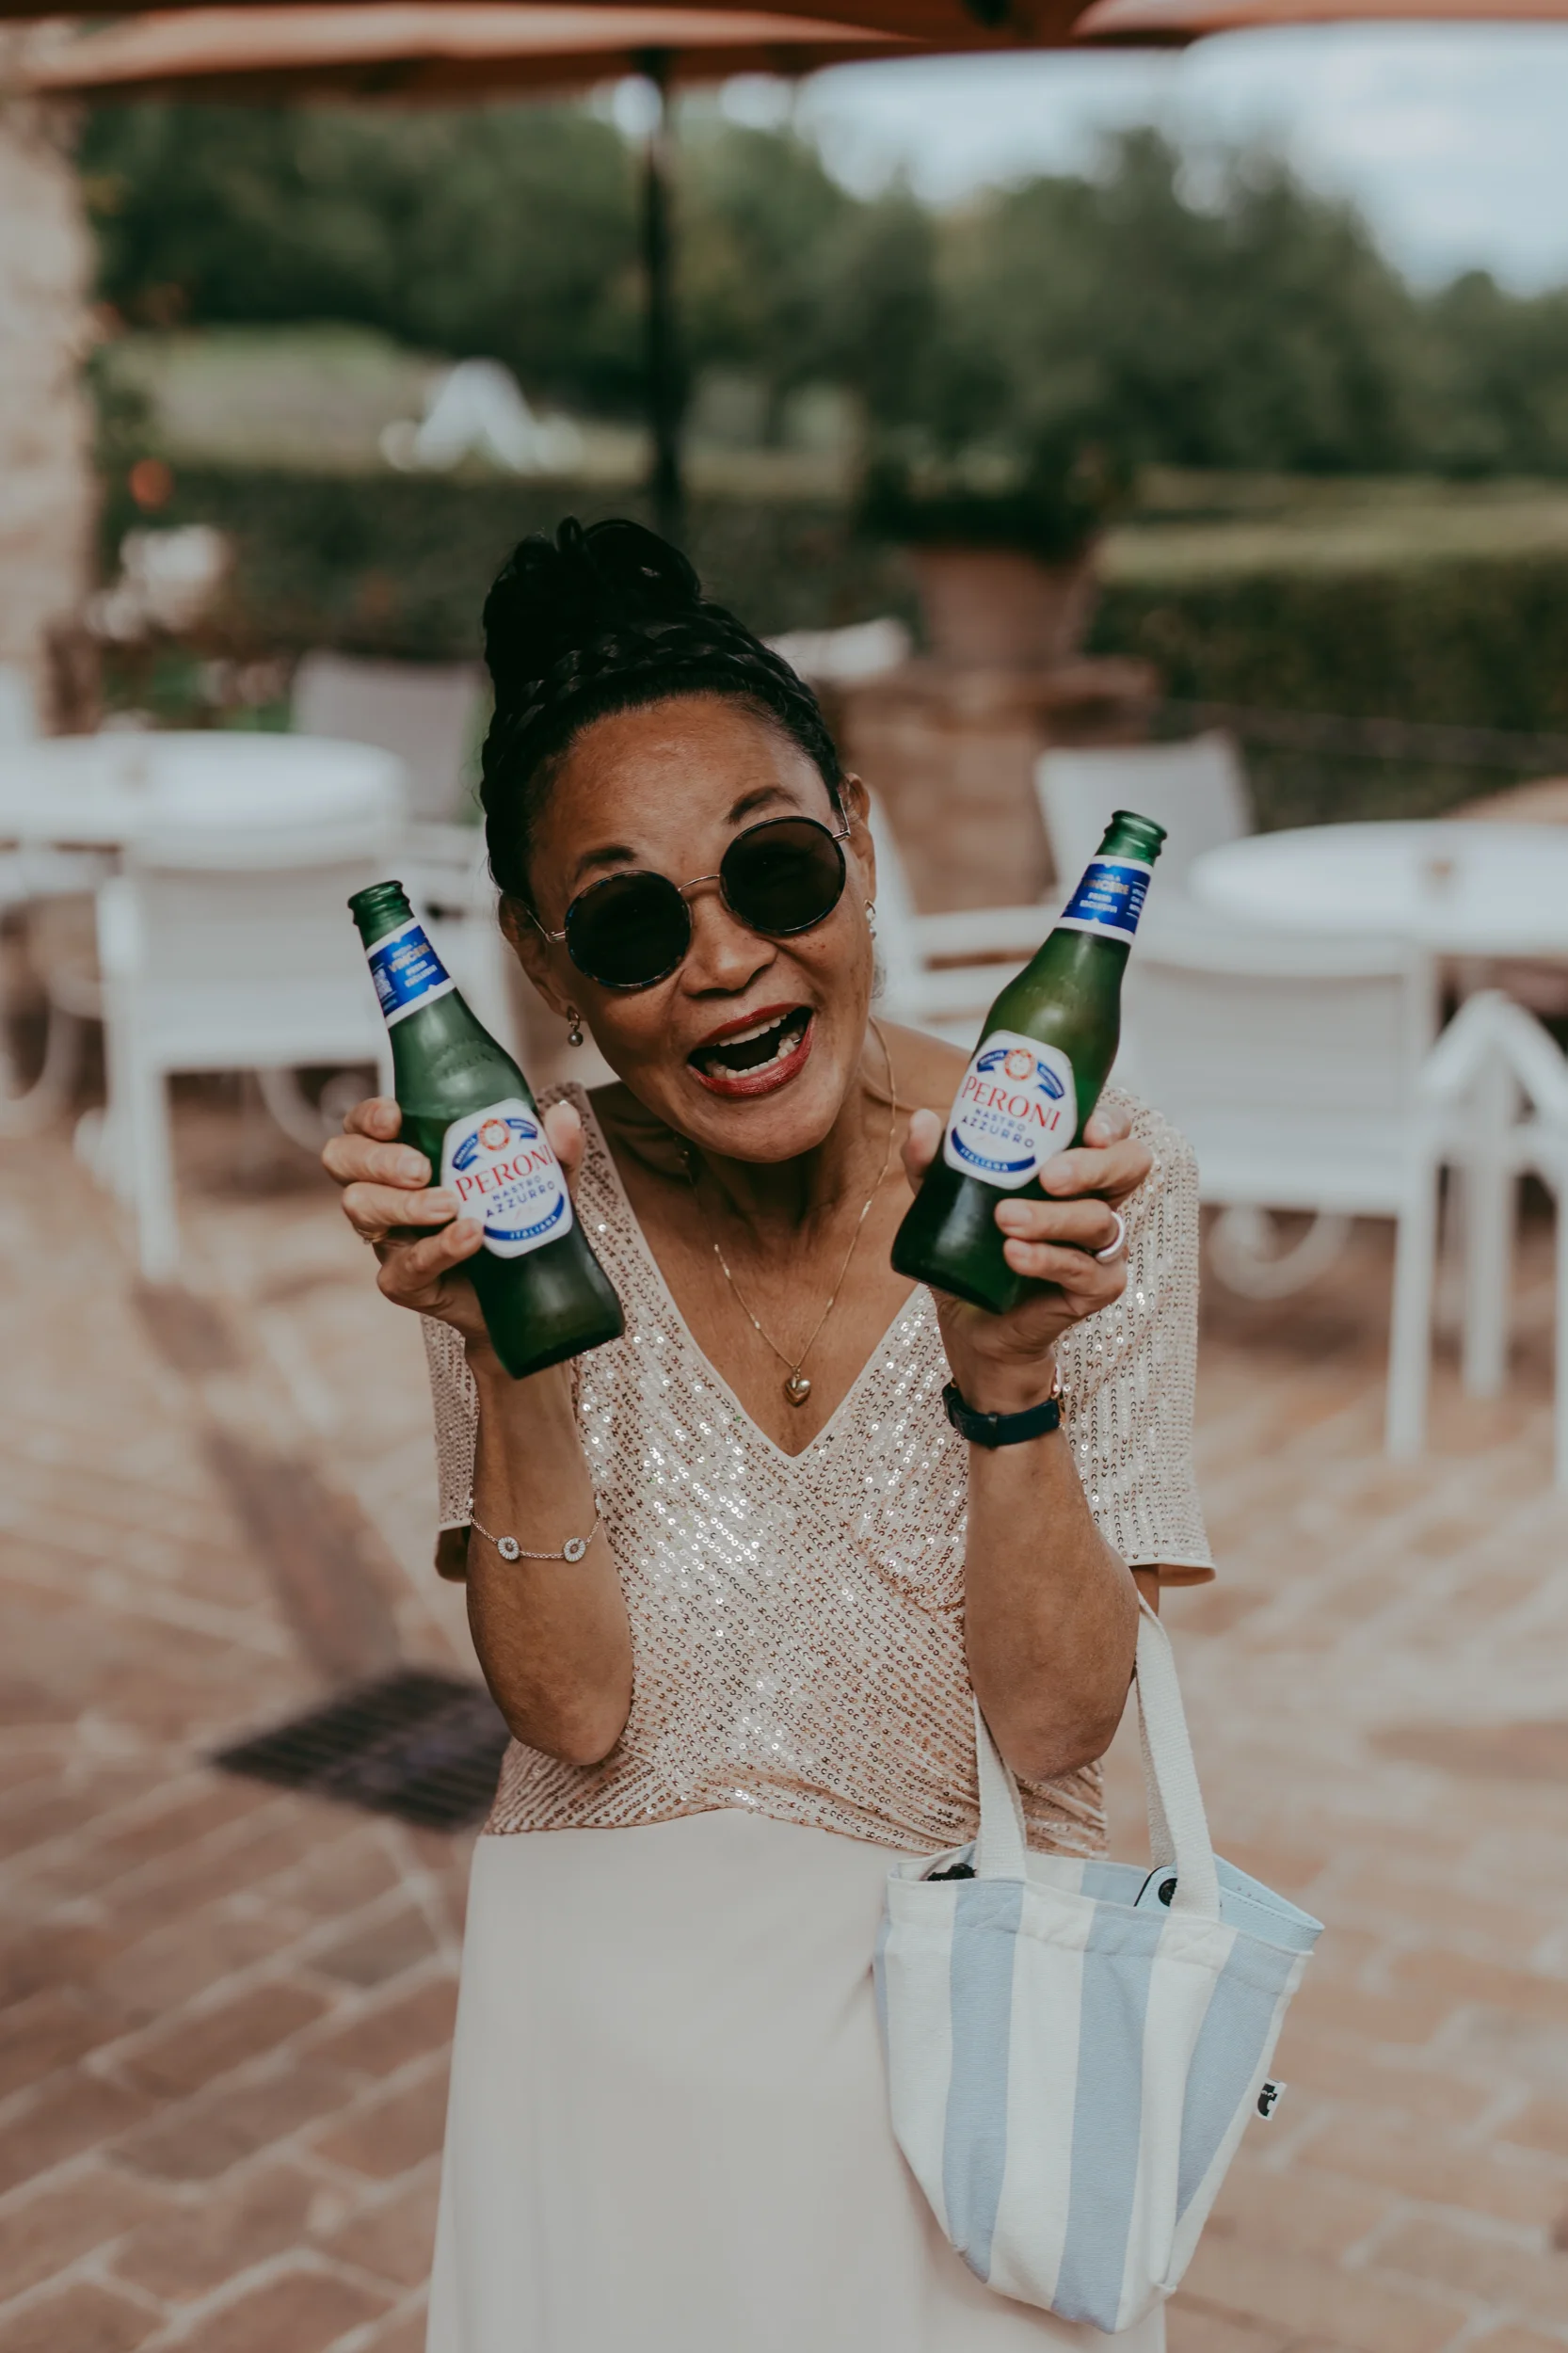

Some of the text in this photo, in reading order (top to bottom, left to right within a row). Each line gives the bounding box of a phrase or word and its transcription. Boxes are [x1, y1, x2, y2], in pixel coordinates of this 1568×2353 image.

[961, 1075, 1061, 1131] PERONI
[975, 1108, 1027, 1132] NASTRO
[961, 1115, 1034, 1148] AZZURRO
[455, 1144, 553, 1201] PERONI
[492, 1175, 541, 1201] NASTRO
[486, 1180, 555, 1218] AZZURRO
